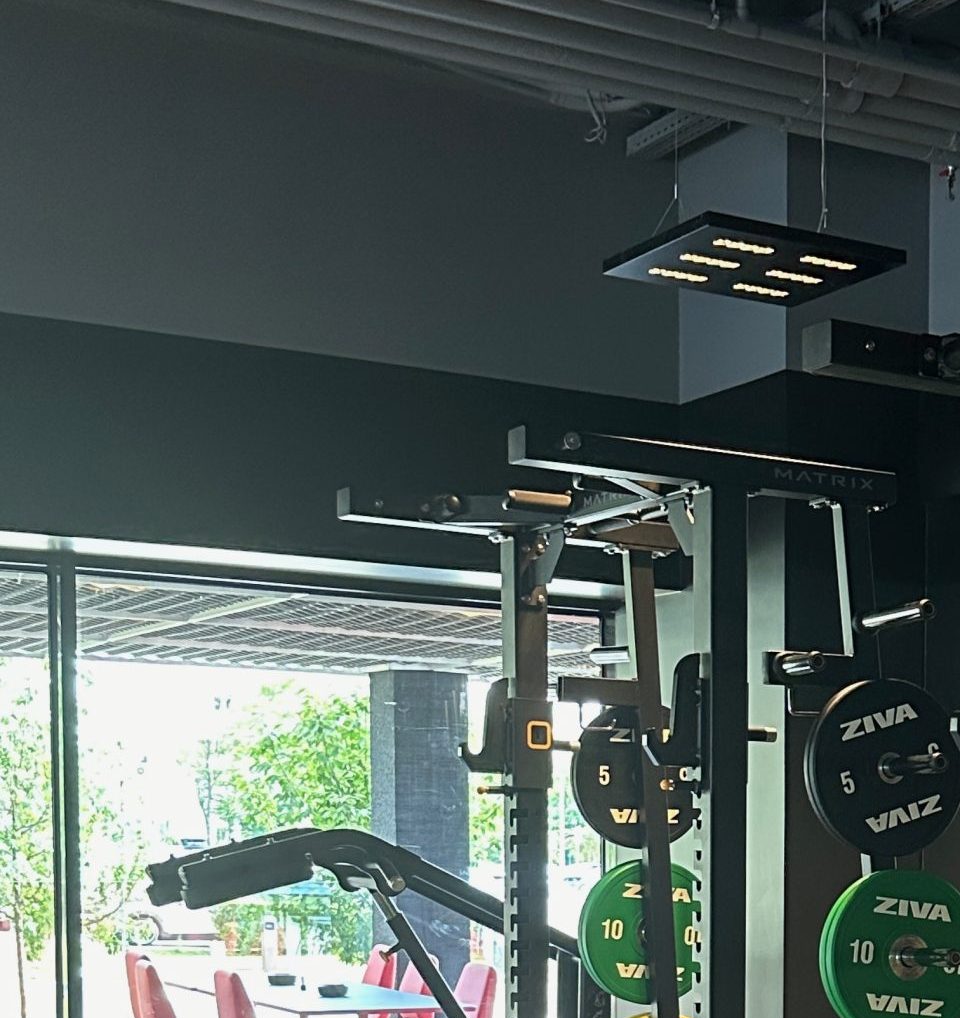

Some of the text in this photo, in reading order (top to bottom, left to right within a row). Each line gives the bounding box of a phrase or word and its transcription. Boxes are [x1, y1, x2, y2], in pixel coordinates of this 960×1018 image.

[773, 467, 874, 490] MATRIX
[840, 703, 919, 742] ZIVA
[598, 765, 611, 786] 5
[840, 771, 856, 795] 5
[610, 808, 680, 824] ZA
[865, 794, 943, 834] ZIVA
[622, 883, 692, 903] ZA
[873, 896, 952, 923] ZIVA
[602, 919, 624, 941] 10
[850, 939, 875, 965] 10
[866, 992, 945, 1018] ZIVA
